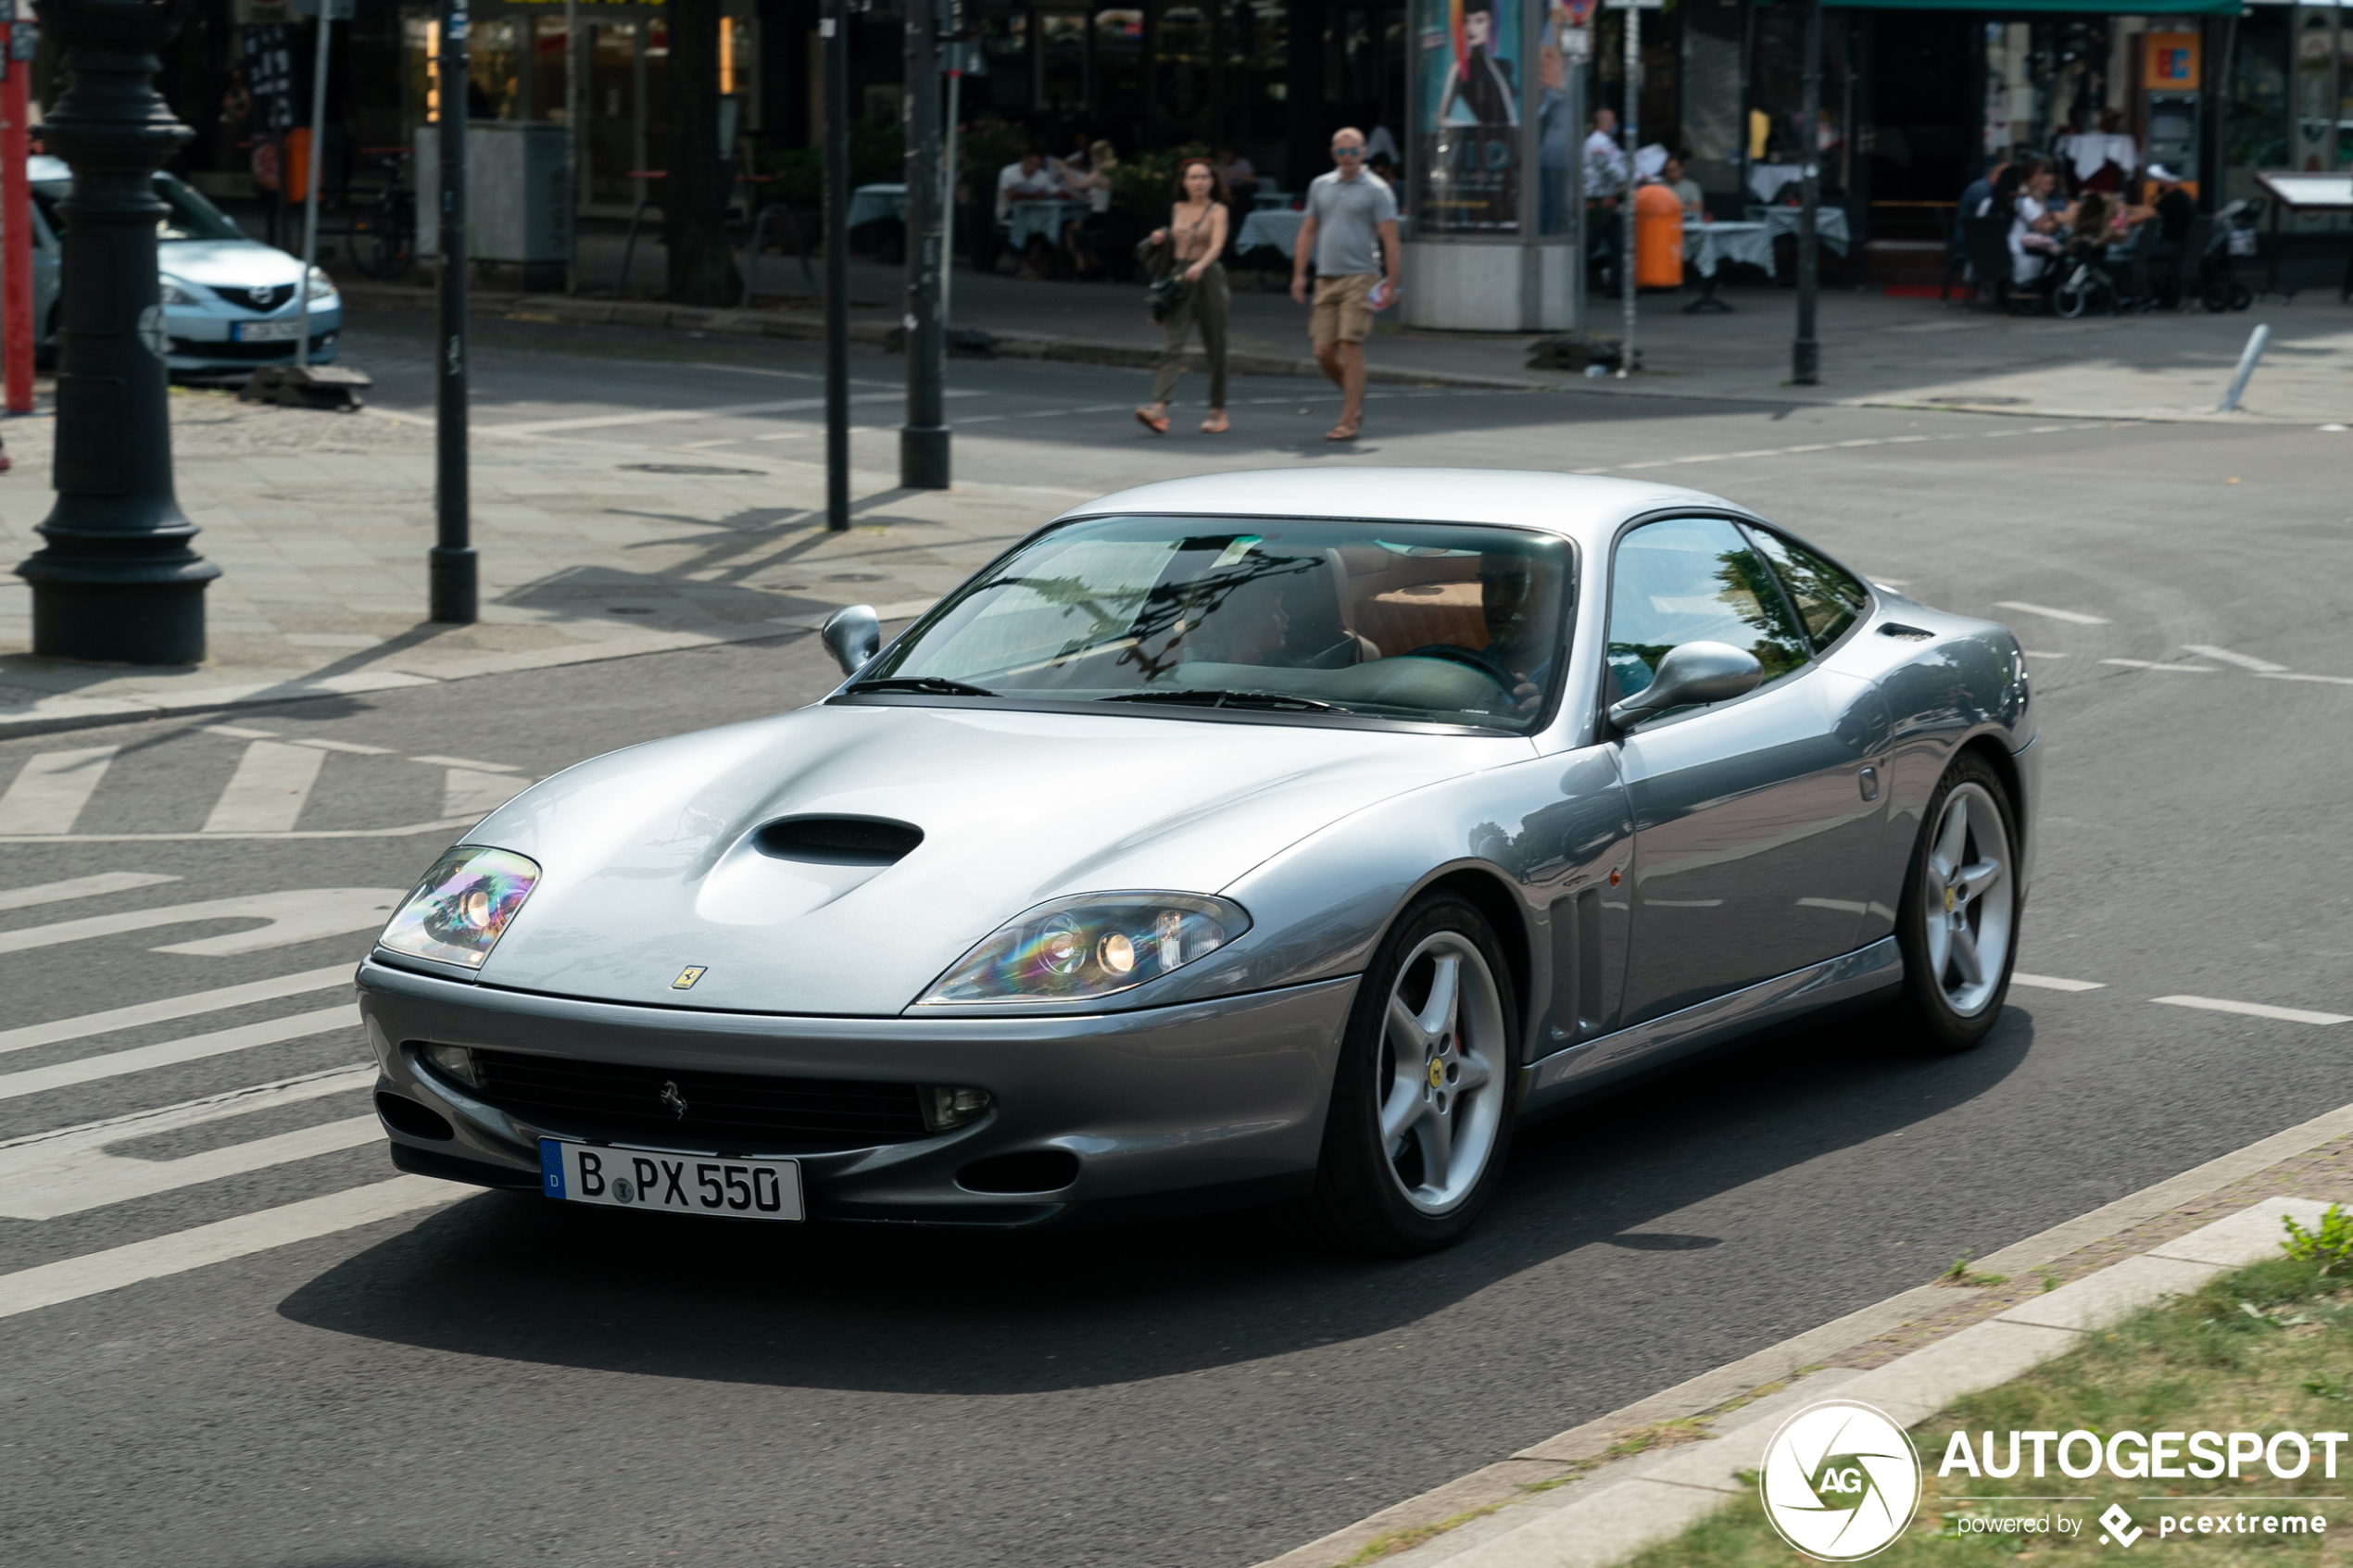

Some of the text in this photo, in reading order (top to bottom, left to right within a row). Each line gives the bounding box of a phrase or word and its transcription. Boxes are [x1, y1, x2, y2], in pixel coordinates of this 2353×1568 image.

[550, 1174, 559, 1186] D
[578, 1150, 781, 1211] B PX 550
